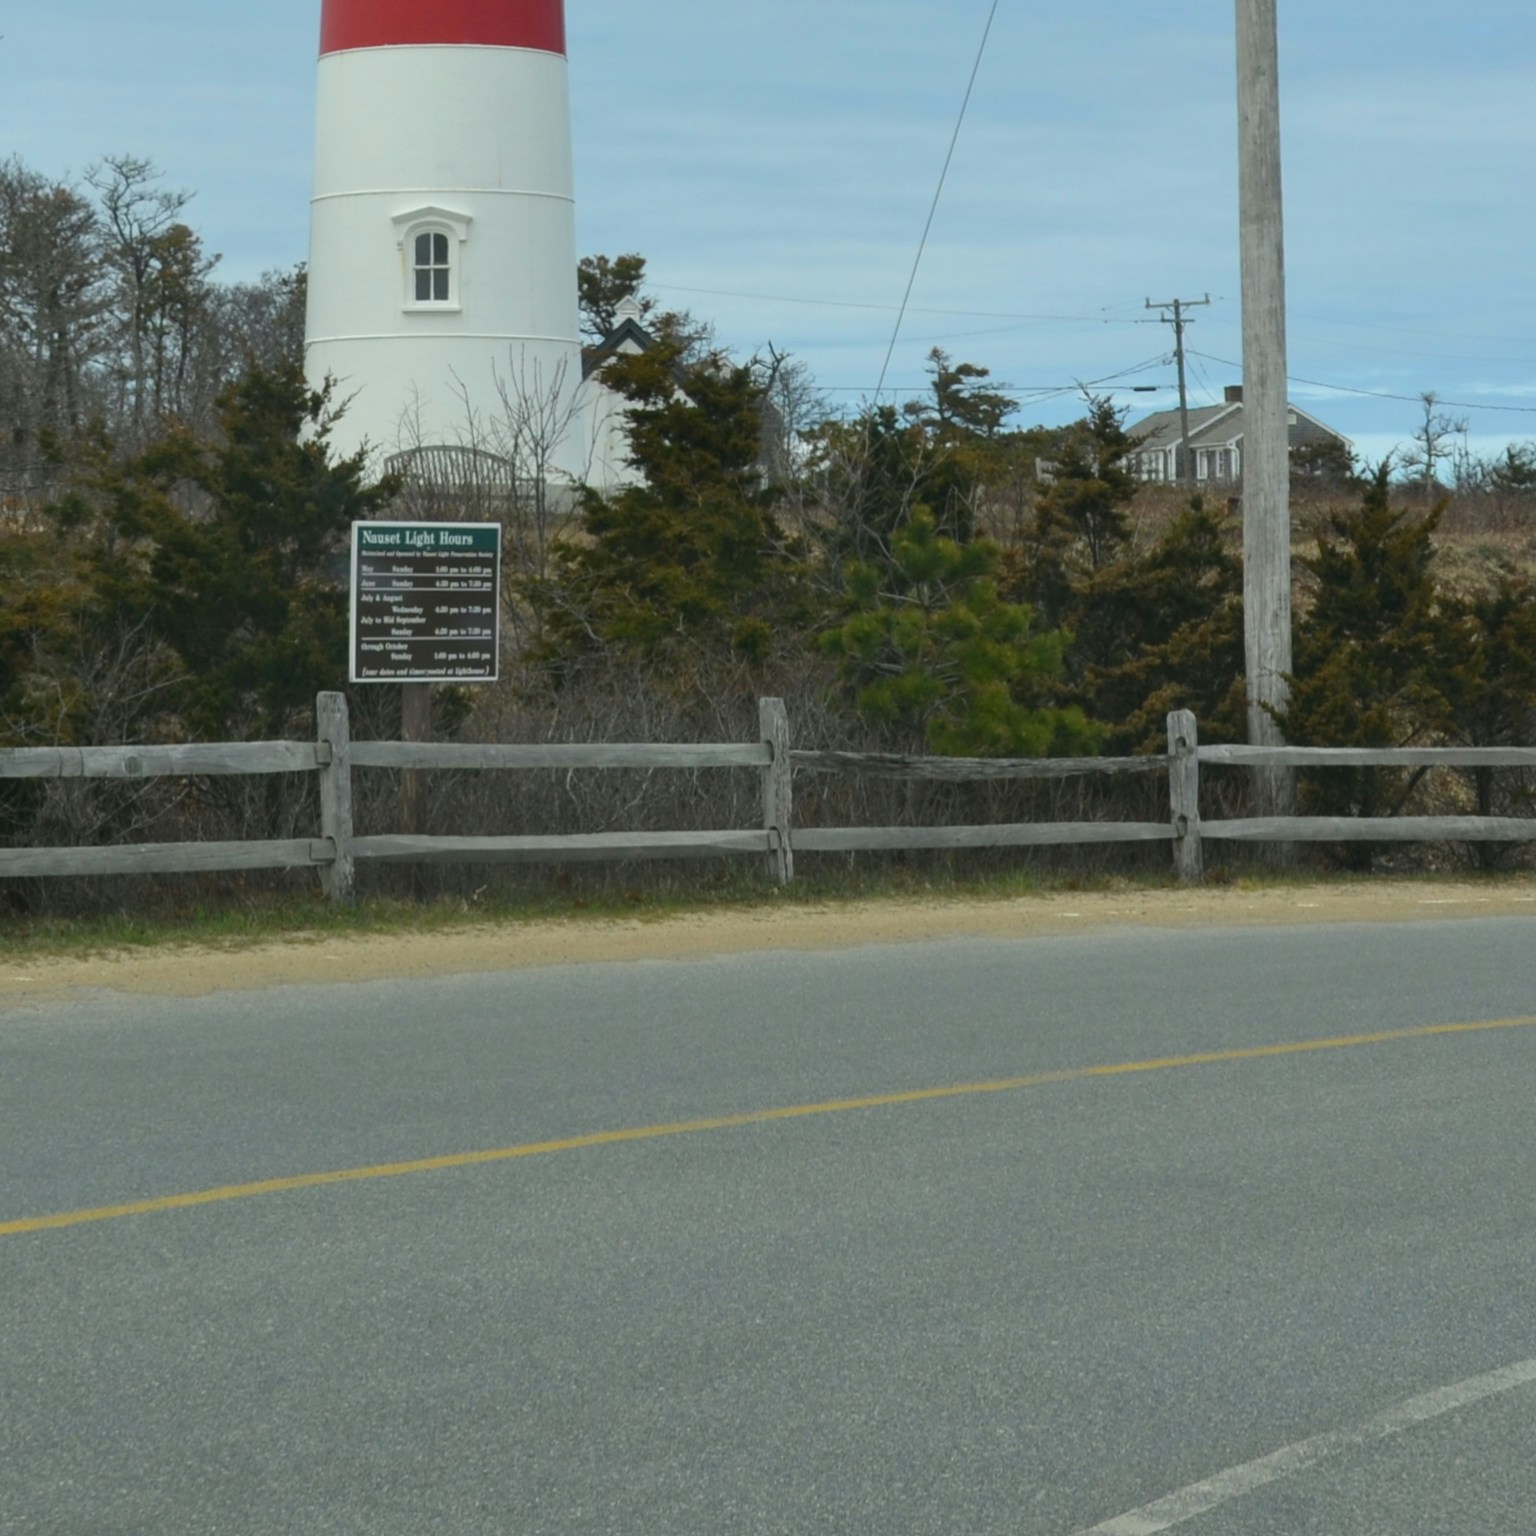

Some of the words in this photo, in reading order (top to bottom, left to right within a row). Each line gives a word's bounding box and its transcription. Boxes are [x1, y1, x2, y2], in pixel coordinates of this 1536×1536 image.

[362, 530, 401, 544] Nauset
[405, 531, 434, 547] Light
[440, 532, 473, 545] Hours
[392, 565, 413, 573] Sunday
[392, 580, 413, 588] Sunday
[361, 594, 373, 602] July
[383, 594, 403, 602] August
[392, 606, 423, 614] Wednesday
[361, 616, 373, 624] July
[396, 616, 426, 624] September
[391, 628, 412, 636] Sunday
[449, 629, 458, 637] pm
[361, 643, 384, 651] through
[391, 652, 412, 661] Sunday
